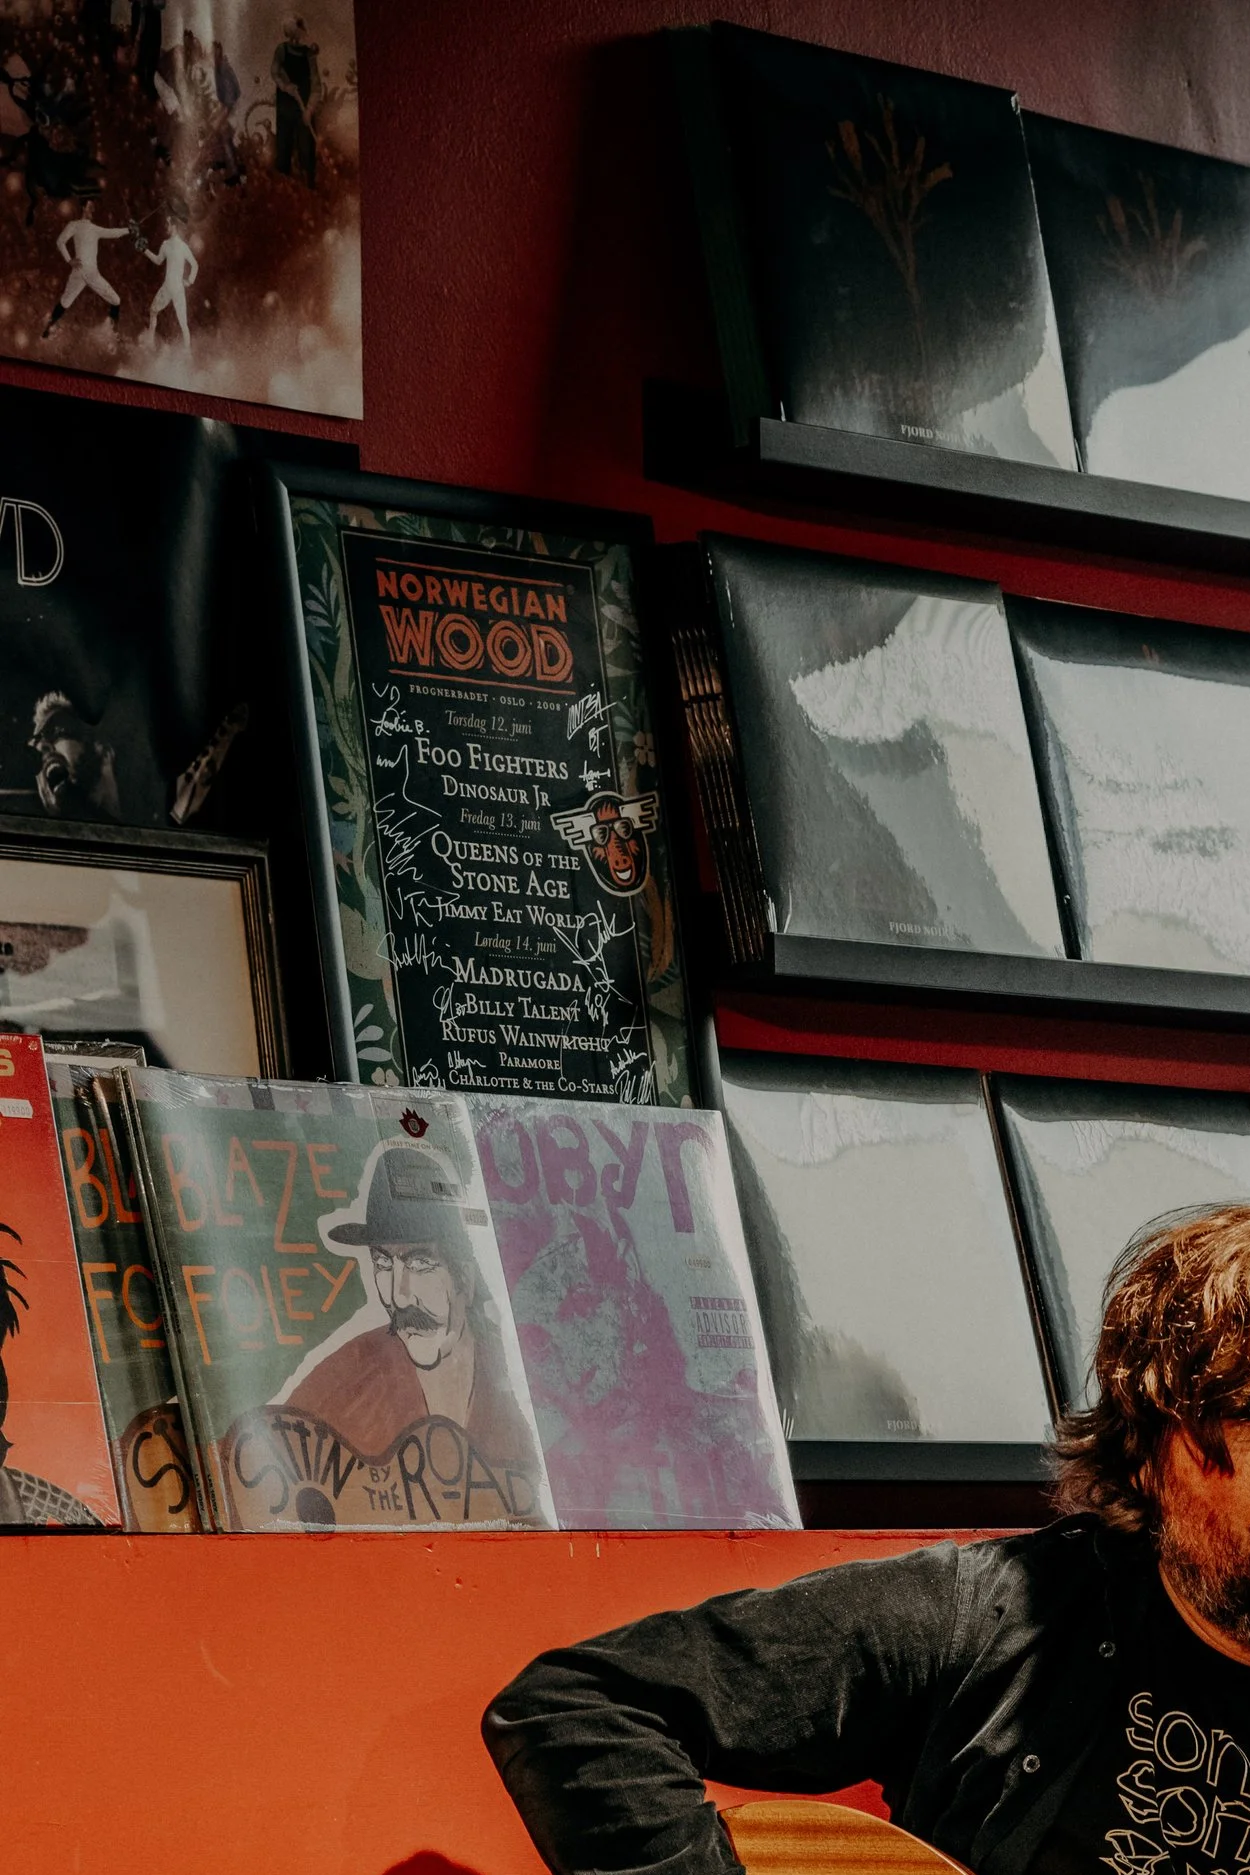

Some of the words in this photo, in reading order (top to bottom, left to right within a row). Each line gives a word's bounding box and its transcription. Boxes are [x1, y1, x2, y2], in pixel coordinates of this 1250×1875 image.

[376, 569, 567, 623] NORWEGIAN
[378, 604, 574, 683] WOOD
[410, 684, 488, 703] FROGNERBADET
[500, 696, 526, 708] OSLO
[537, 700, 561, 712] 2008
[445, 709, 487, 733] Torsdag
[491, 715, 508, 732] 12.
[510, 717, 532, 736] juni
[459, 808, 496, 830] Fredag
[500, 813, 517, 828] 13.
[518, 815, 541, 833] juni
[431, 831, 519, 866] QUEENS
[523, 852, 543, 866] OF
[548, 854, 581, 871] THE
[451, 862, 520, 895] STONE
[526, 870, 571, 900] AGE
[889, 921, 922, 935] FJORD
[515, 934, 533, 952] 14.
[535, 937, 557, 956] juni
[451, 956, 586, 992] MADRUGADA
[523, 1080, 532, 1090] &
[535, 1081, 555, 1091] THE
[161, 1133, 347, 1254] BLAZE
[182, 1259, 356, 1366] FOLEY
[696, 1312, 751, 1334] ADVISOR
[368, 1466, 391, 1484] BY
[397, 1421, 536, 1520] ROAD
[362, 1482, 403, 1512] THE
